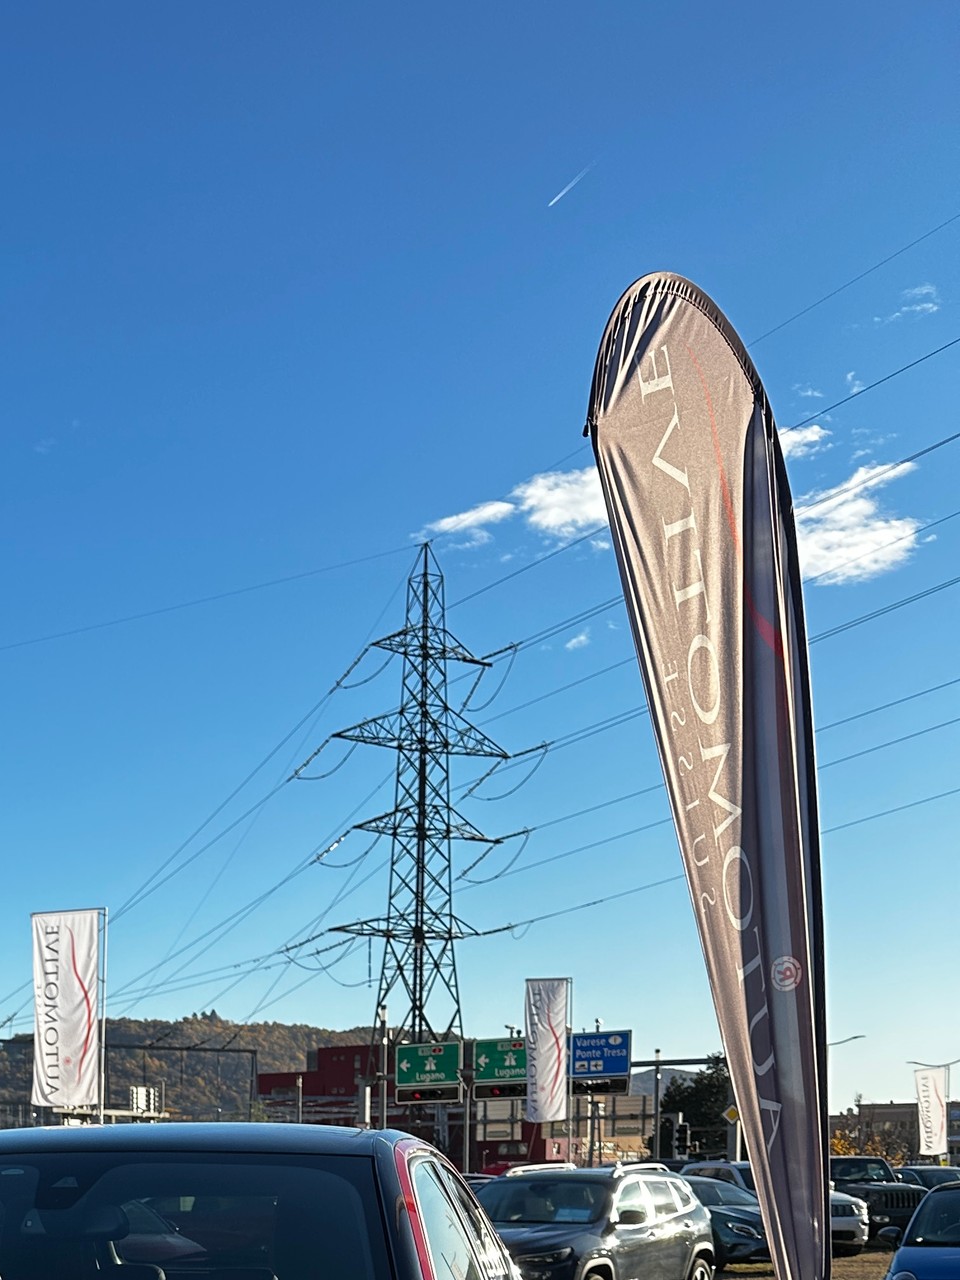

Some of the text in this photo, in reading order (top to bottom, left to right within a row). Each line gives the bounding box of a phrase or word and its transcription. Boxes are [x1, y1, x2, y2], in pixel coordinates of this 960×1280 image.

[575, 1037, 606, 1047] Varese
[575, 1047, 627, 1058] Ponte Tresa
[415, 1071, 445, 1082] Lugano
[494, 1067, 526, 1078] Lugano
